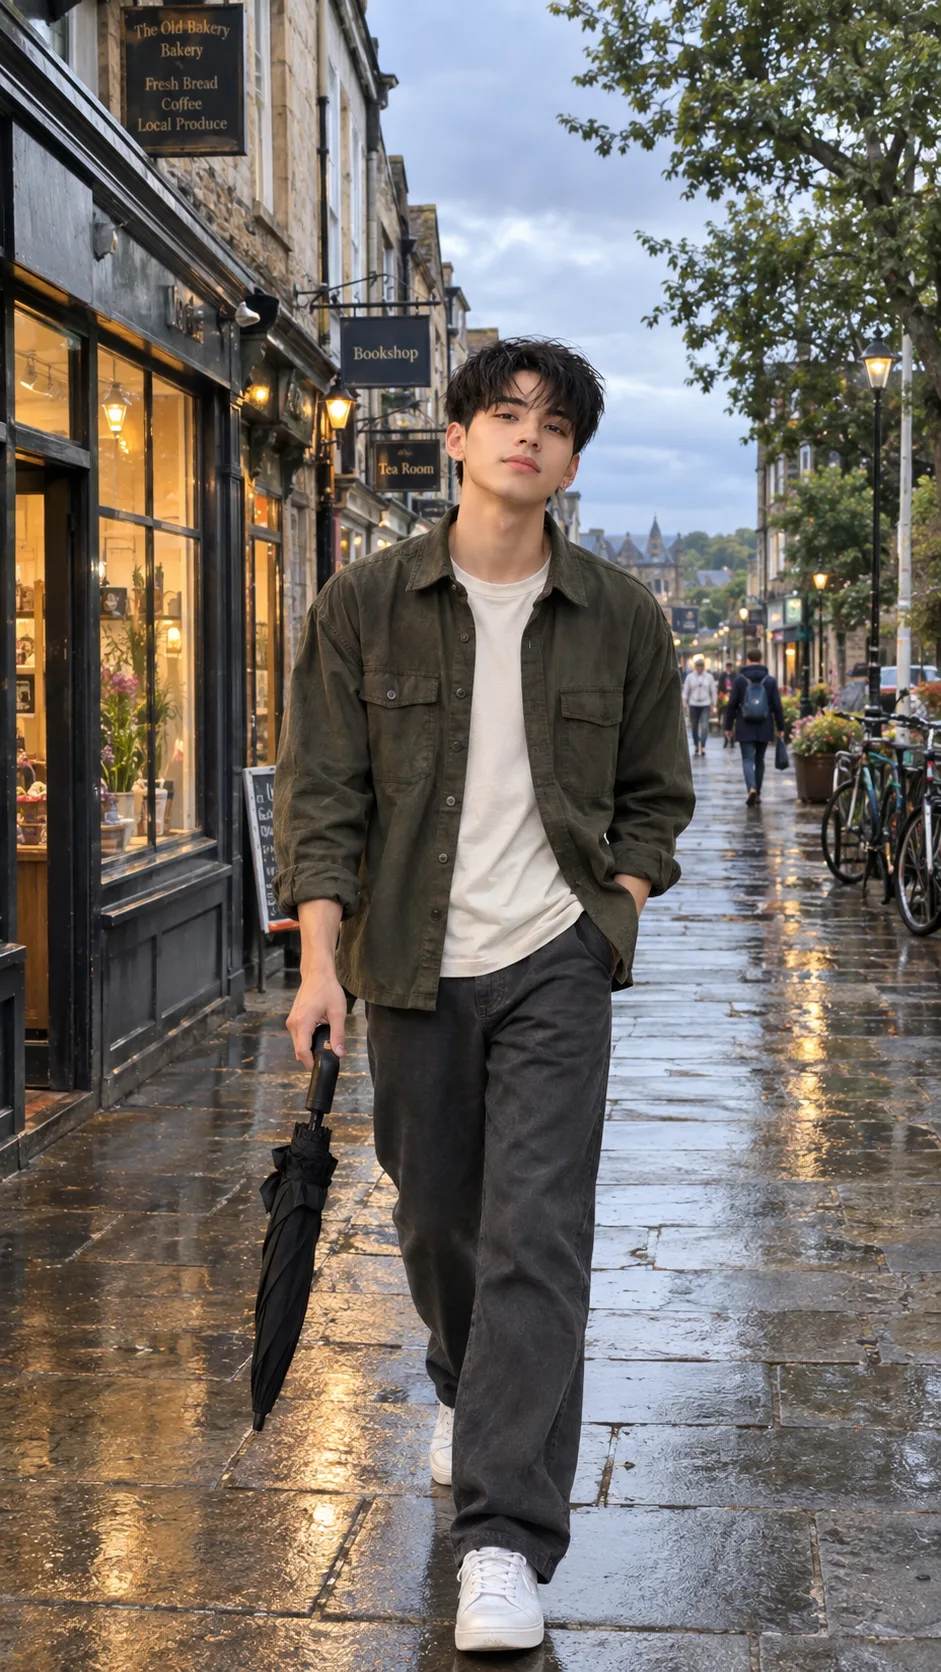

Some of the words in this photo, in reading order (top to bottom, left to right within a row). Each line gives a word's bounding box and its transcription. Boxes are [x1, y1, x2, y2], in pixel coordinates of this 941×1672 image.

[134, 23, 158, 39] The
[187, 20, 230, 40] Bakery
[161, 42, 203, 60] Bakery
[145, 76, 179, 91] Fresh
[183, 75, 218, 90] Bread
[161, 97, 202, 112] Coffee
[138, 117, 172, 132] Local
[176, 116, 228, 131] Produce
[353, 345, 419, 363] Bookshop
[378, 462, 398, 475] Tea
[401, 462, 434, 475] Room
